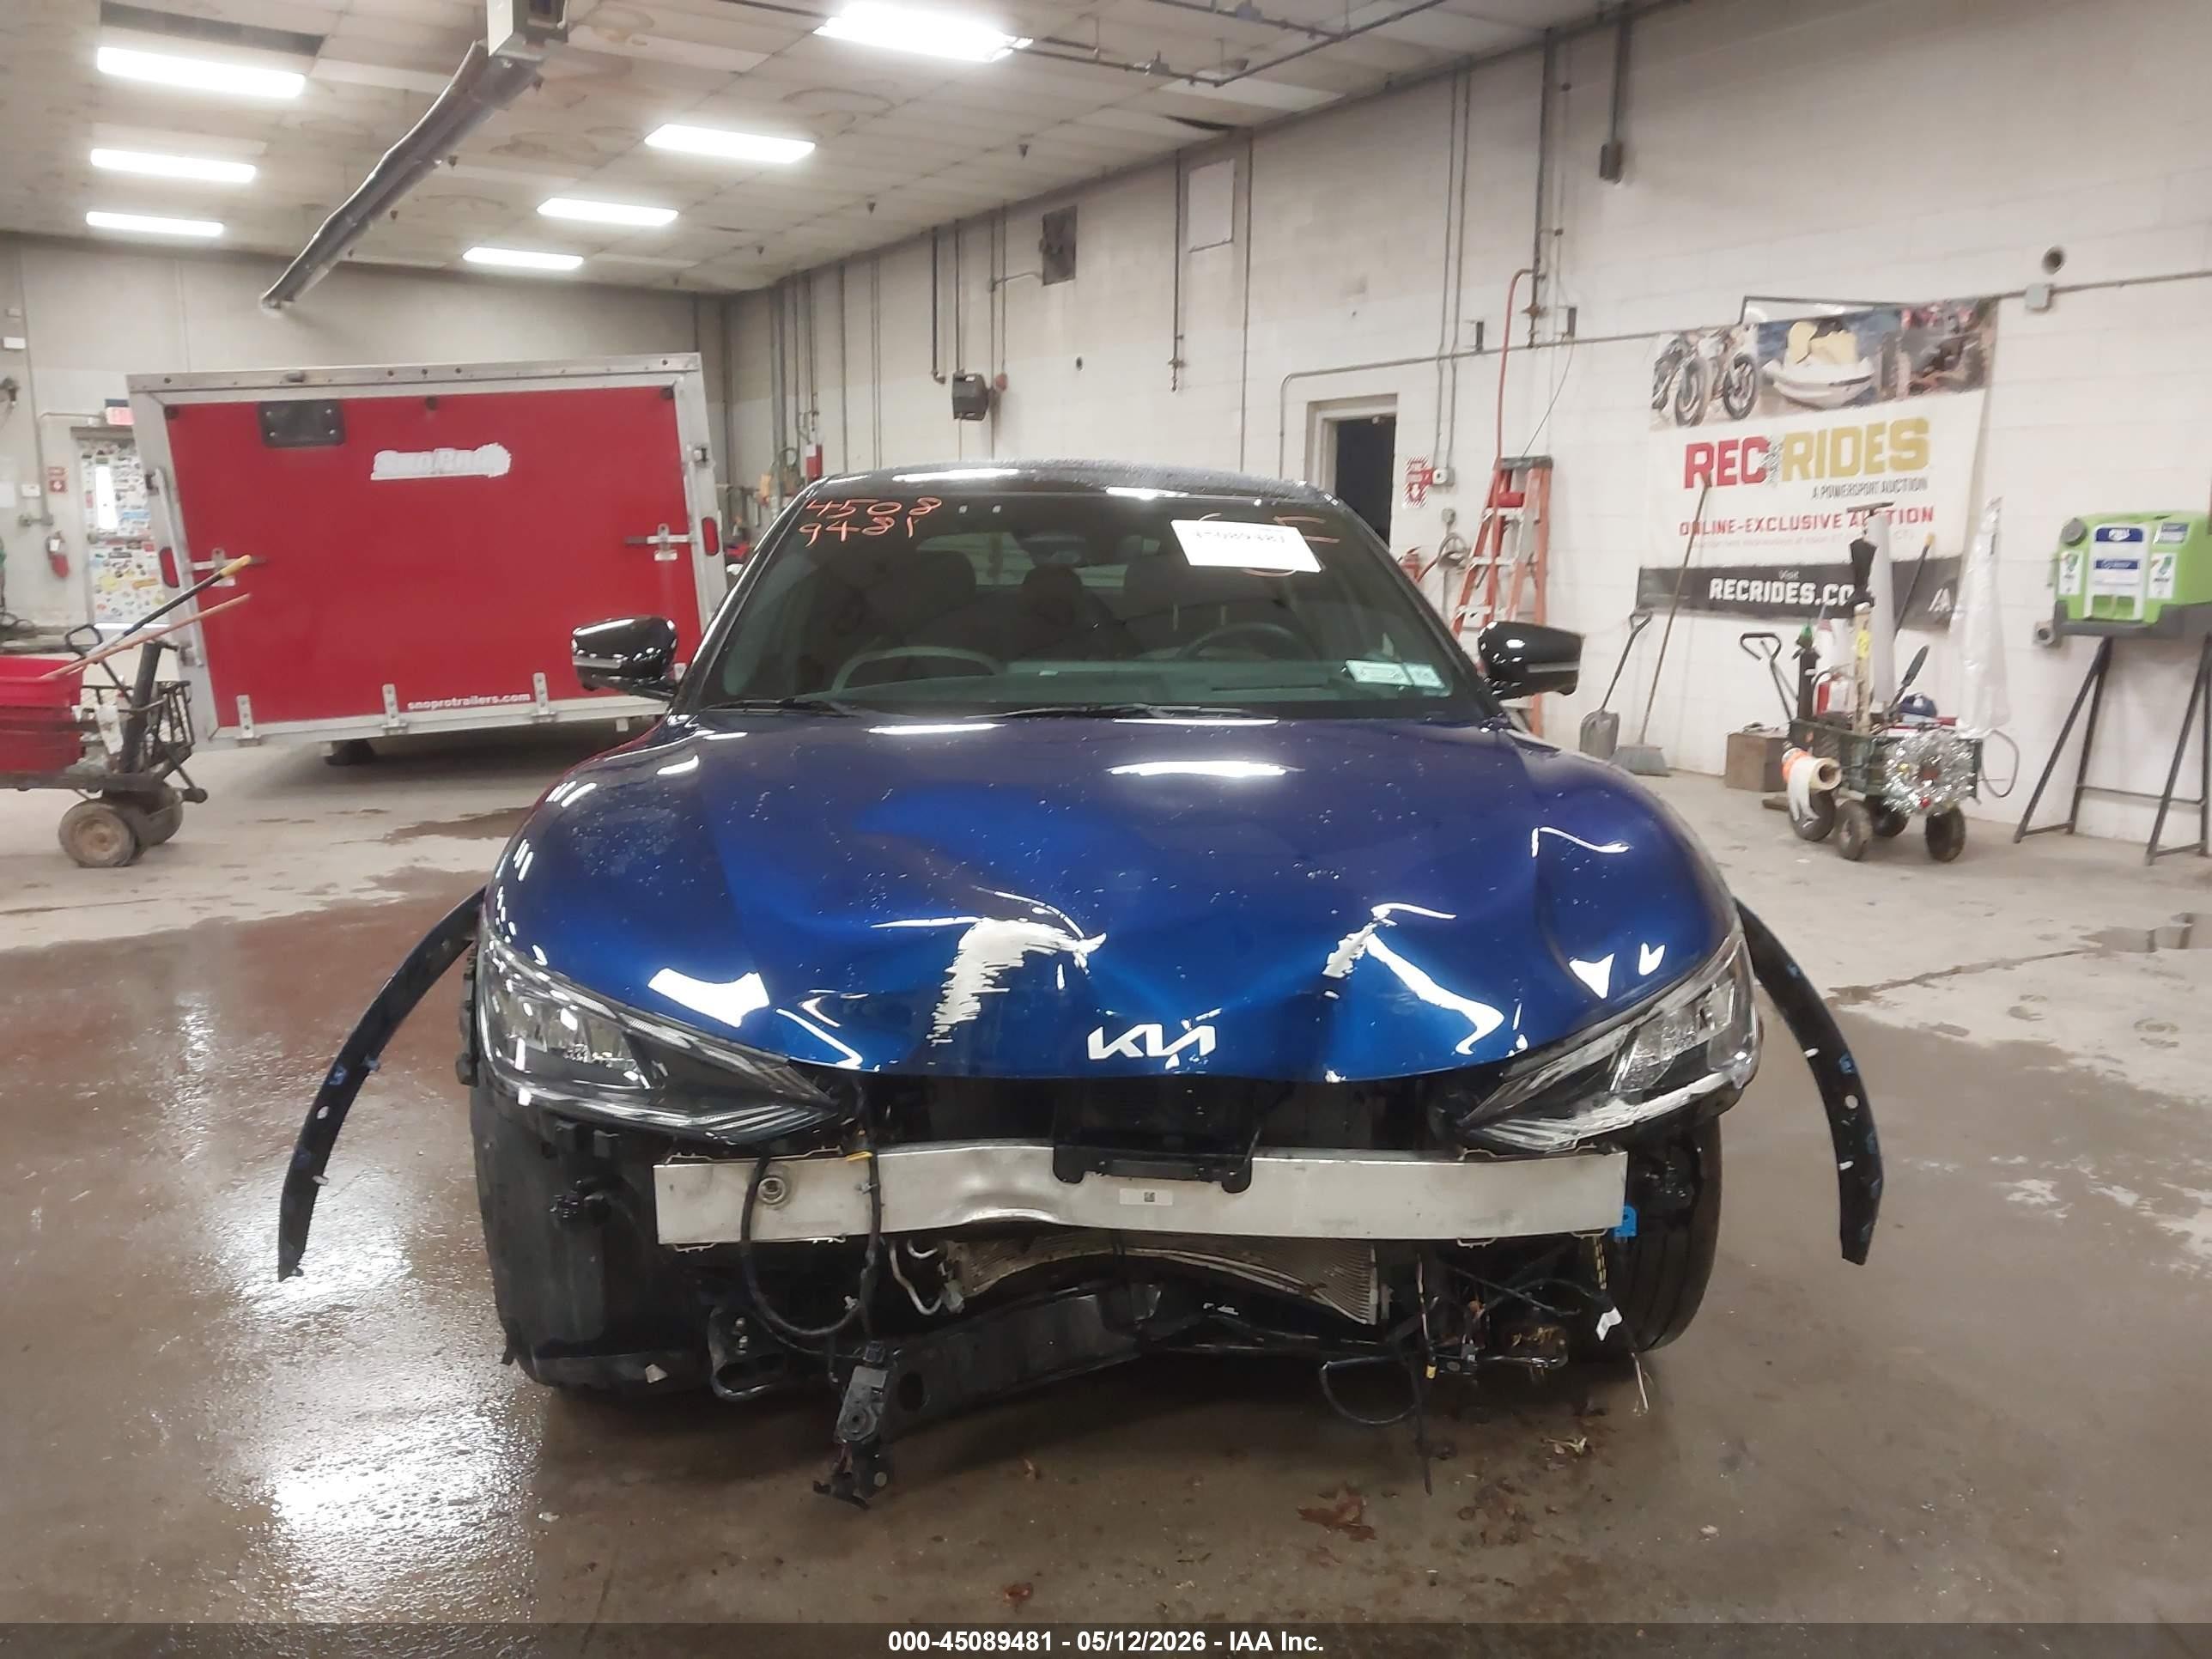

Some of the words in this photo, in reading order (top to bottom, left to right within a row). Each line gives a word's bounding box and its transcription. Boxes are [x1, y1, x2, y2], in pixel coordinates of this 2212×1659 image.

[1685, 436, 1770, 489] REC
[1781, 418, 1929, 481] RIDES
[1820, 481, 1878, 497] POWERSPORT
[1881, 477, 1928, 492] AUCTION
[805, 495, 943, 520] 4508
[1680, 514, 1842, 536] ONLINE-EXCLUSIVE
[1848, 507, 1934, 527] ATION
[1778, 569, 1800, 580] Visit
[1708, 578, 1856, 606] RECRIDES.CO
[408, 694, 531, 709] snoprotrailers.com
[1087, 1024, 1216, 1060] KIA
